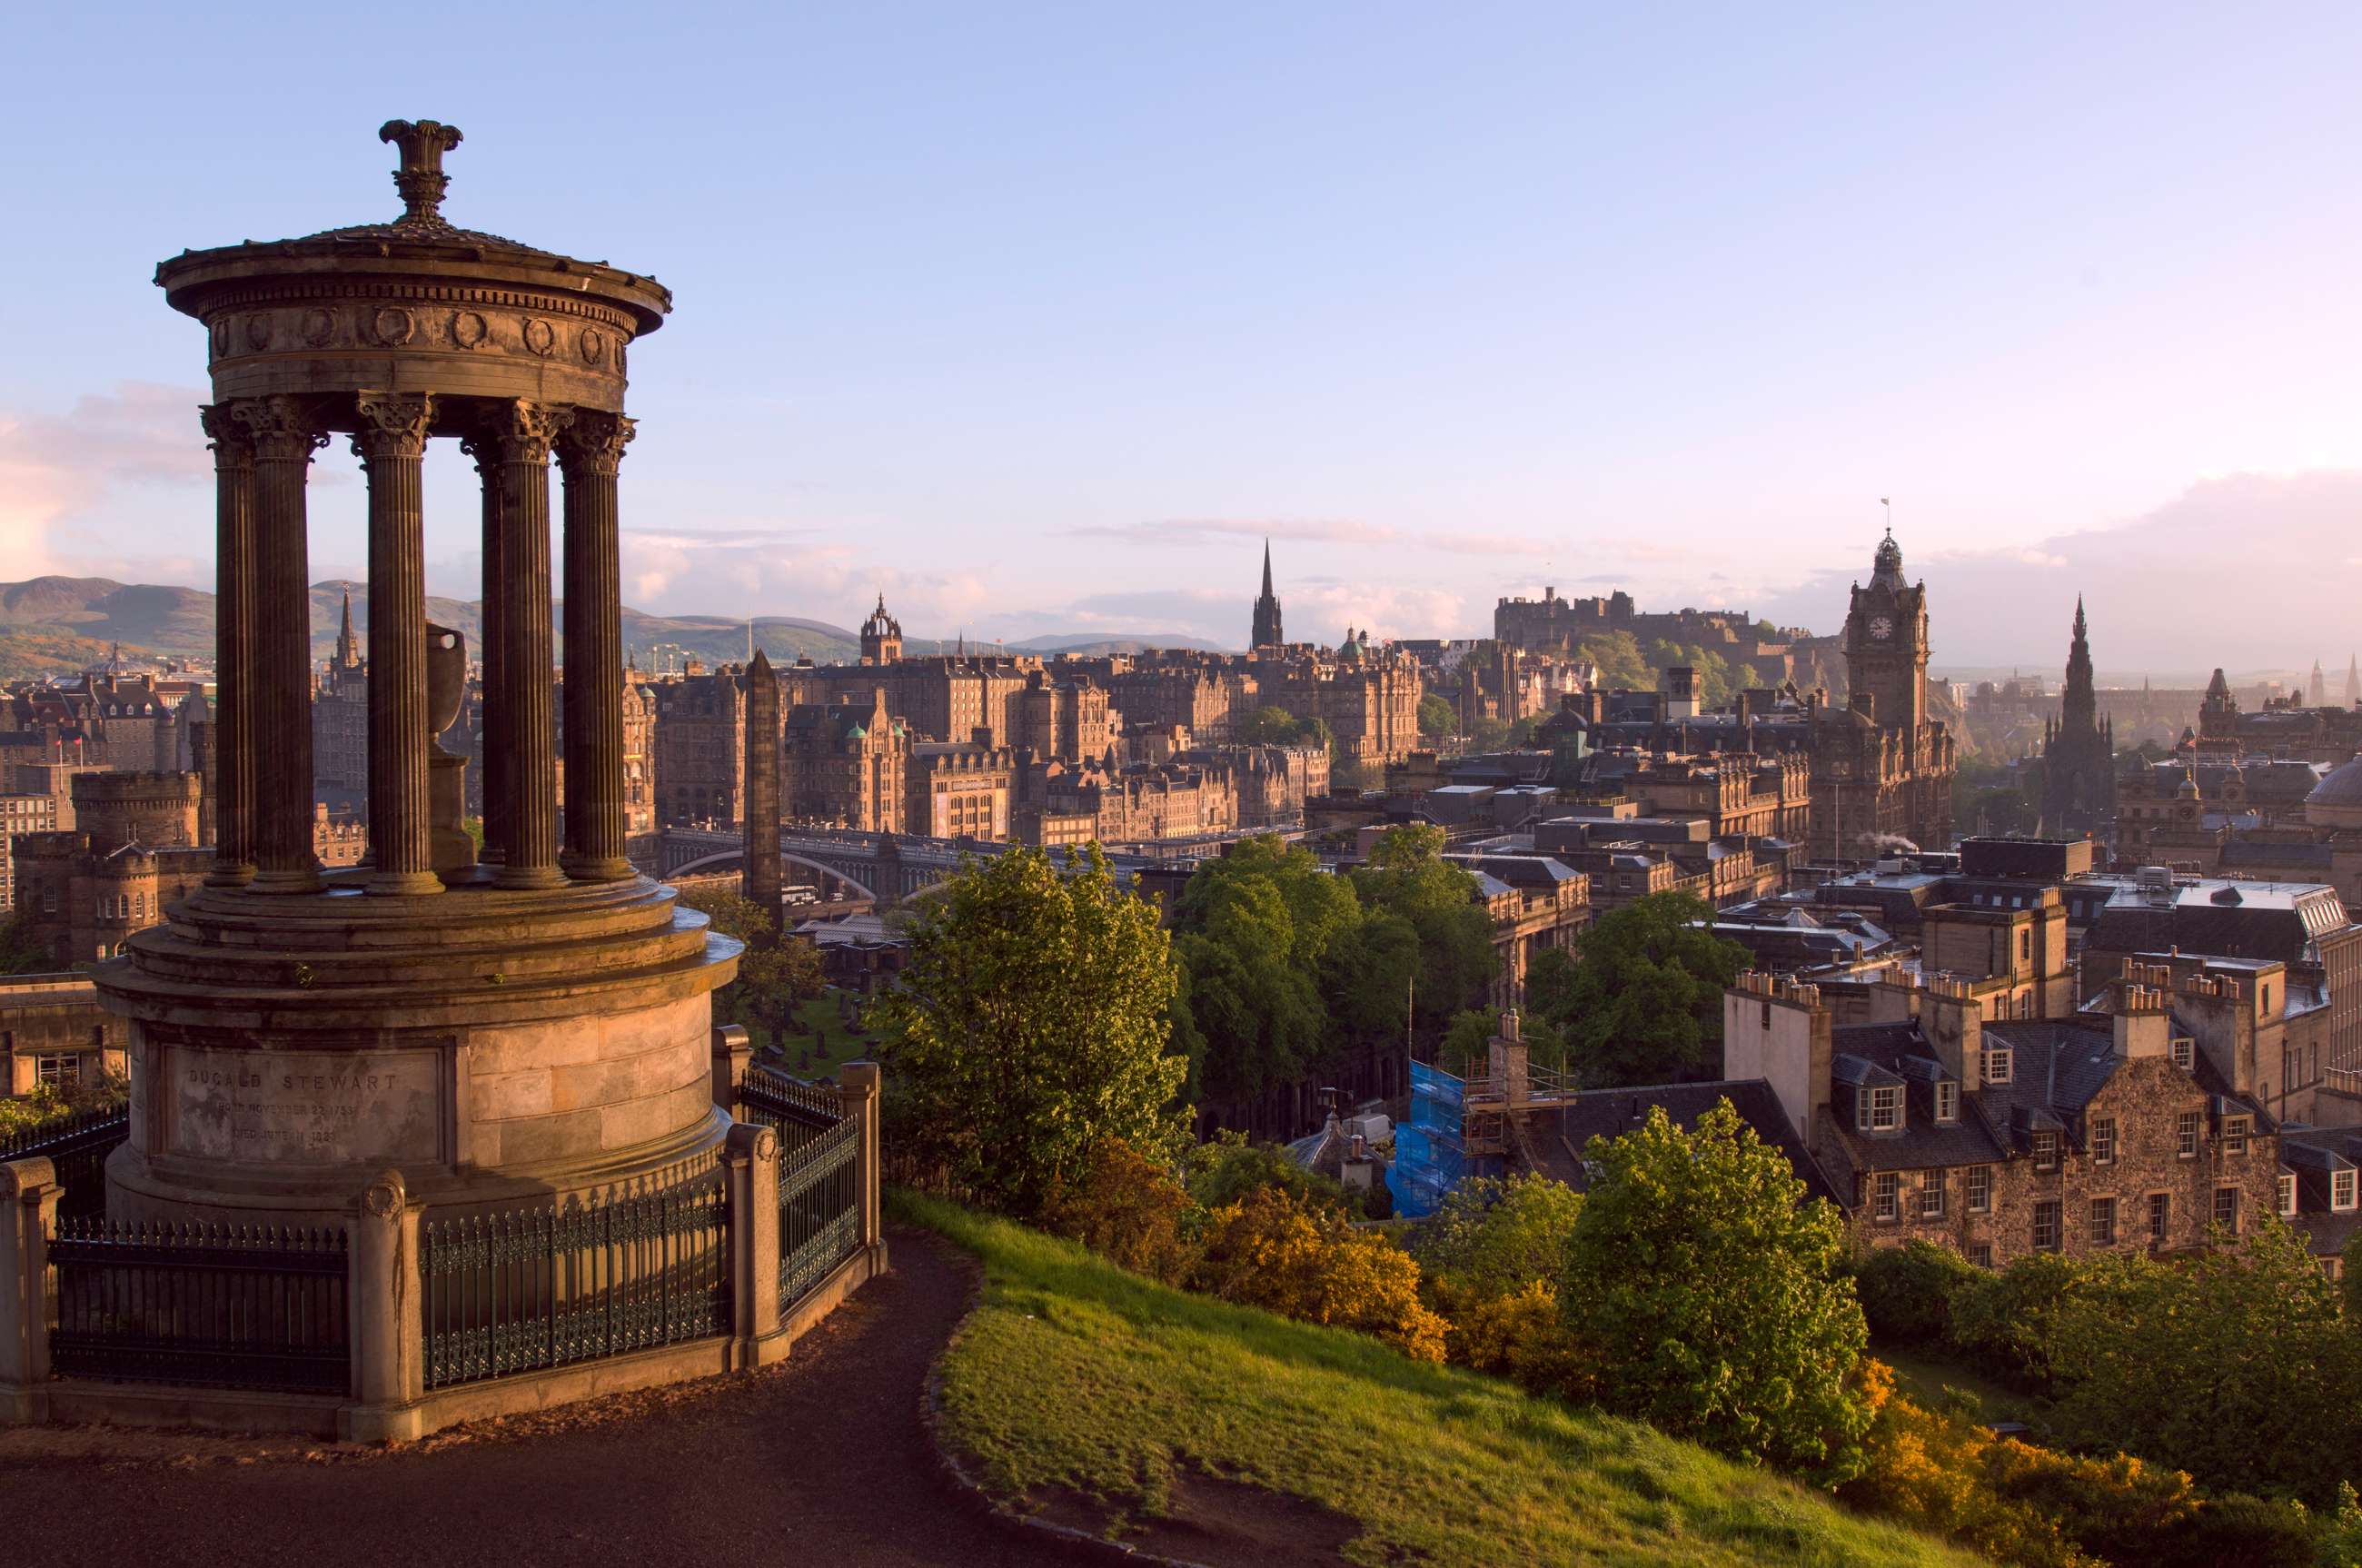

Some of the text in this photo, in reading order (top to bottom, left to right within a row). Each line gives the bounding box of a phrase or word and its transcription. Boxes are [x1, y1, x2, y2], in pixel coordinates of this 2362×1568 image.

[188, 1069, 397, 1090] DUGALD STEWART
[311, 1105, 326, 1116] 22
[232, 1128, 256, 1140] DIED
